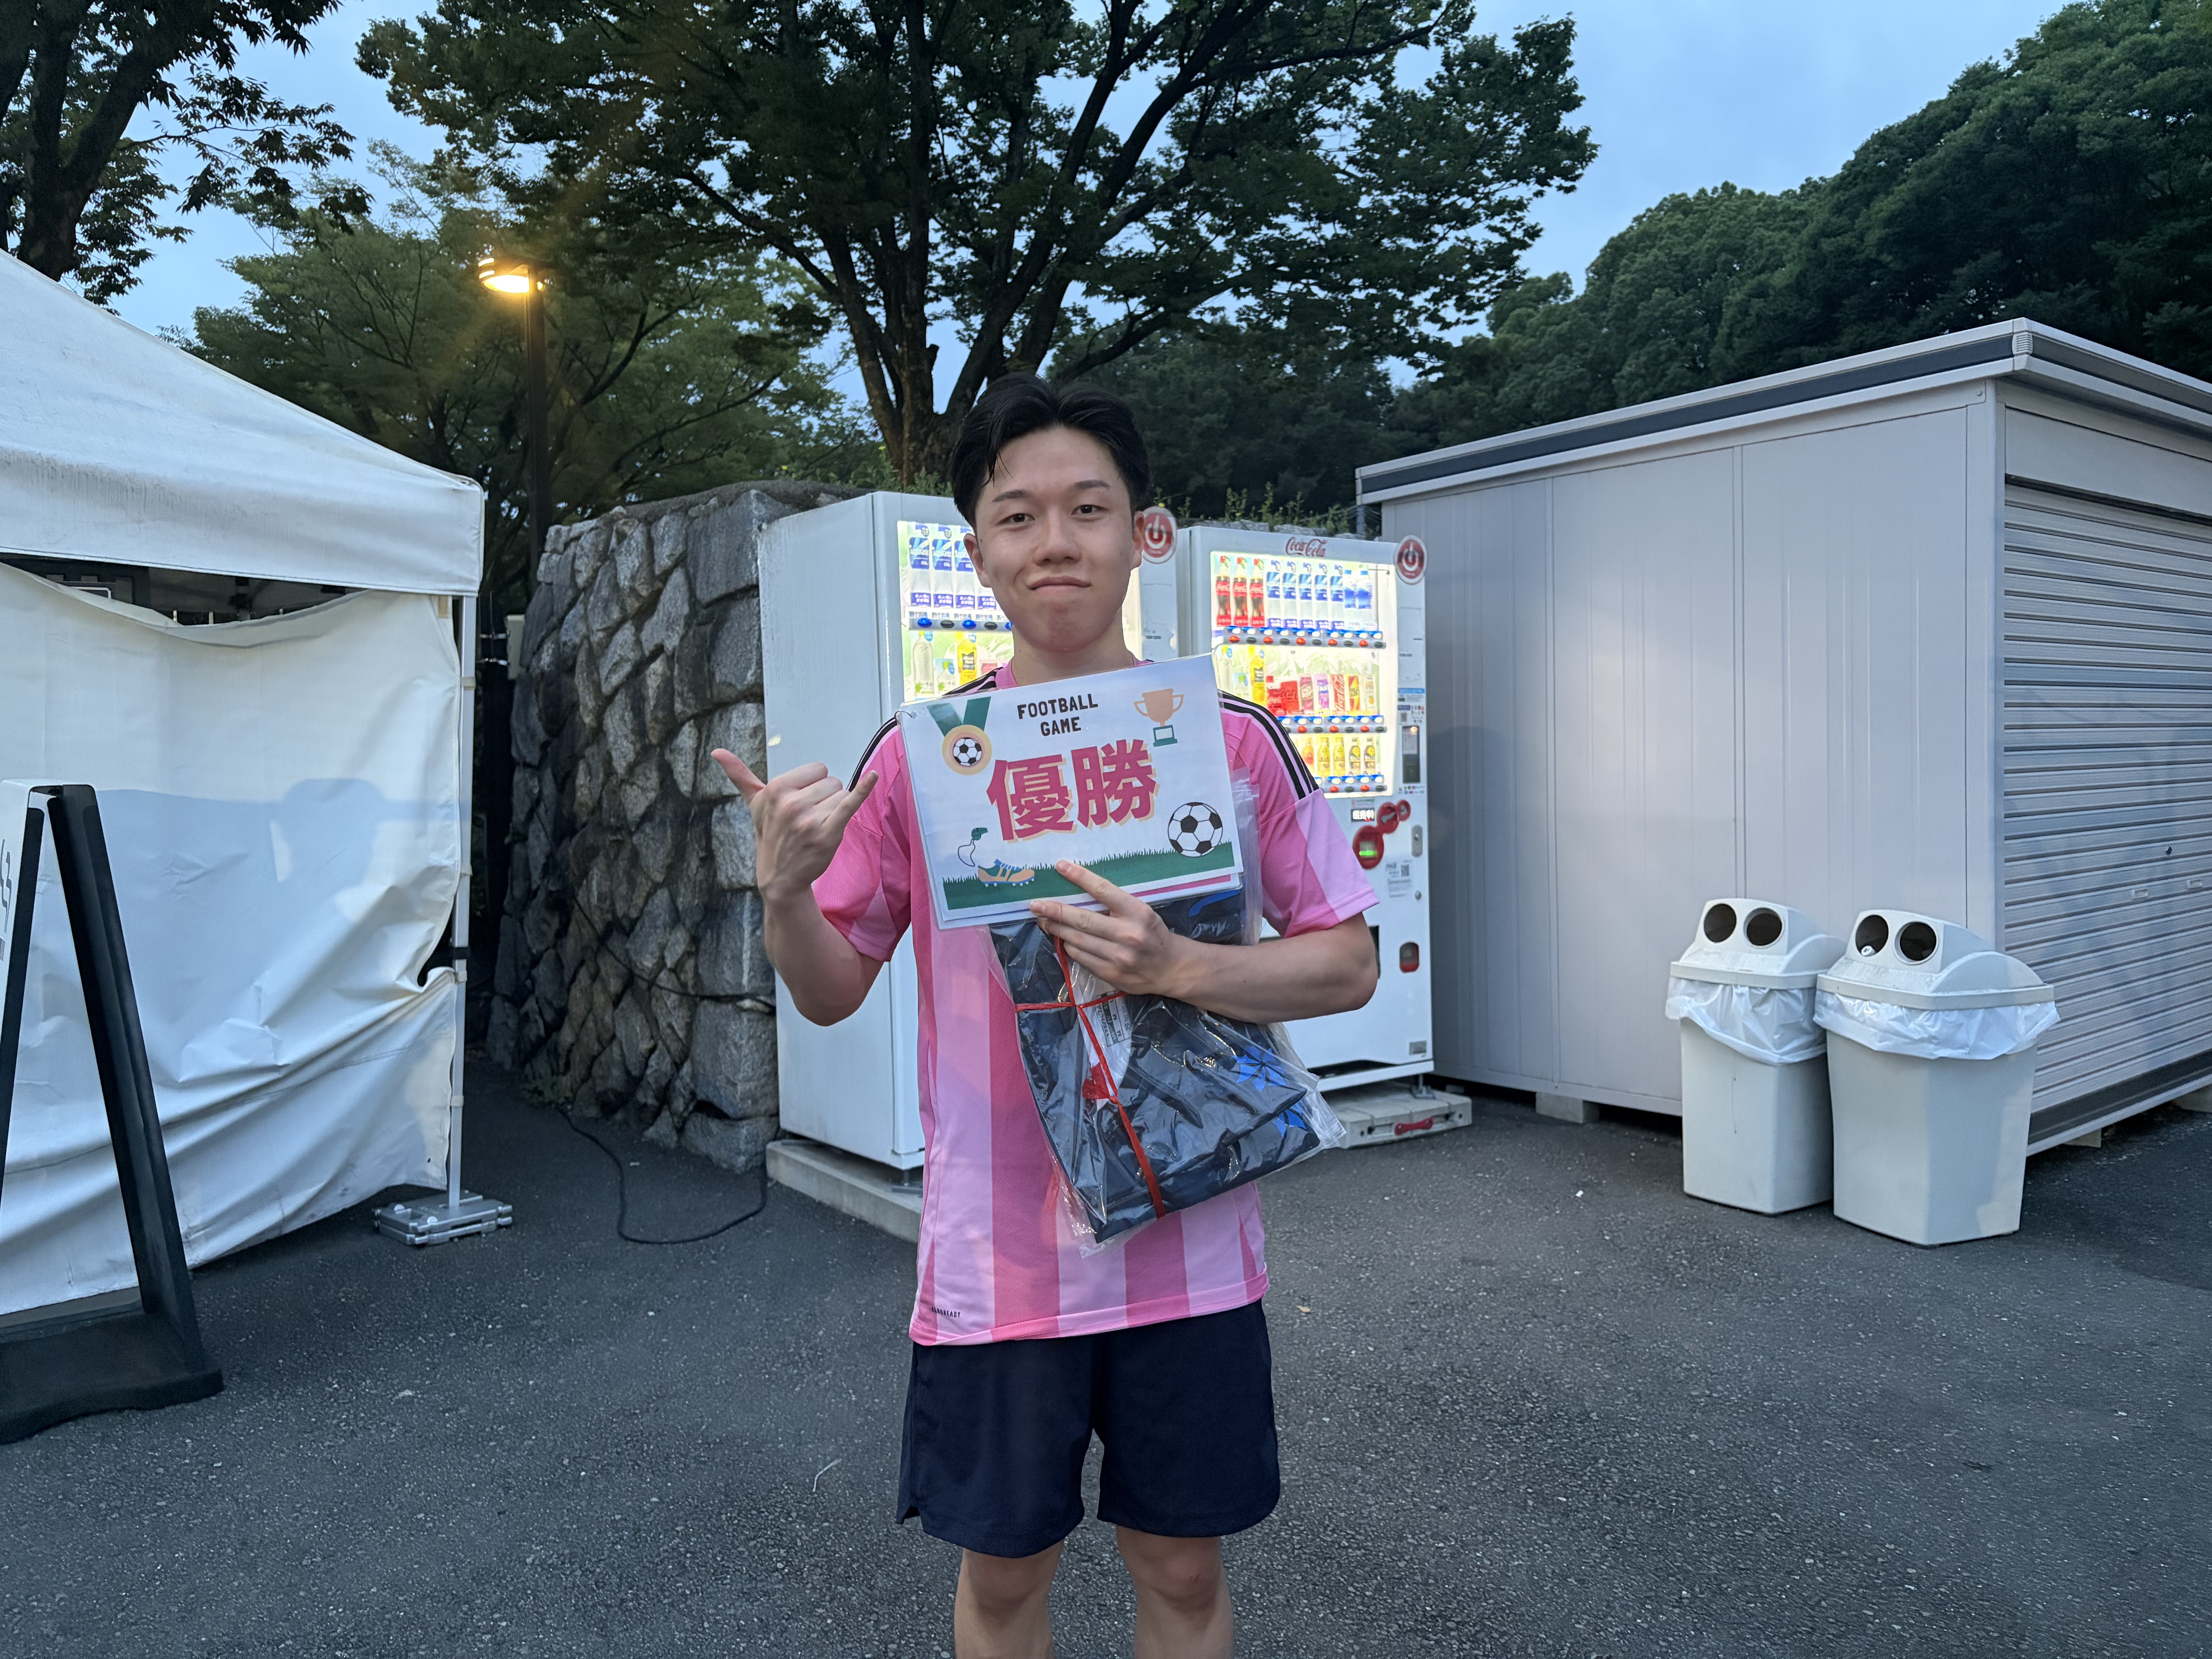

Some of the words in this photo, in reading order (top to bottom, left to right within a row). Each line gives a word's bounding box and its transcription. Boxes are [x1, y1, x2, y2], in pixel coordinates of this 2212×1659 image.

[1285, 537, 1328, 557] Coca-Cola
[1017, 693, 1098, 720] FOOTBALL
[1040, 716, 1082, 736] GAME
[986, 739, 1159, 842] 優勝
